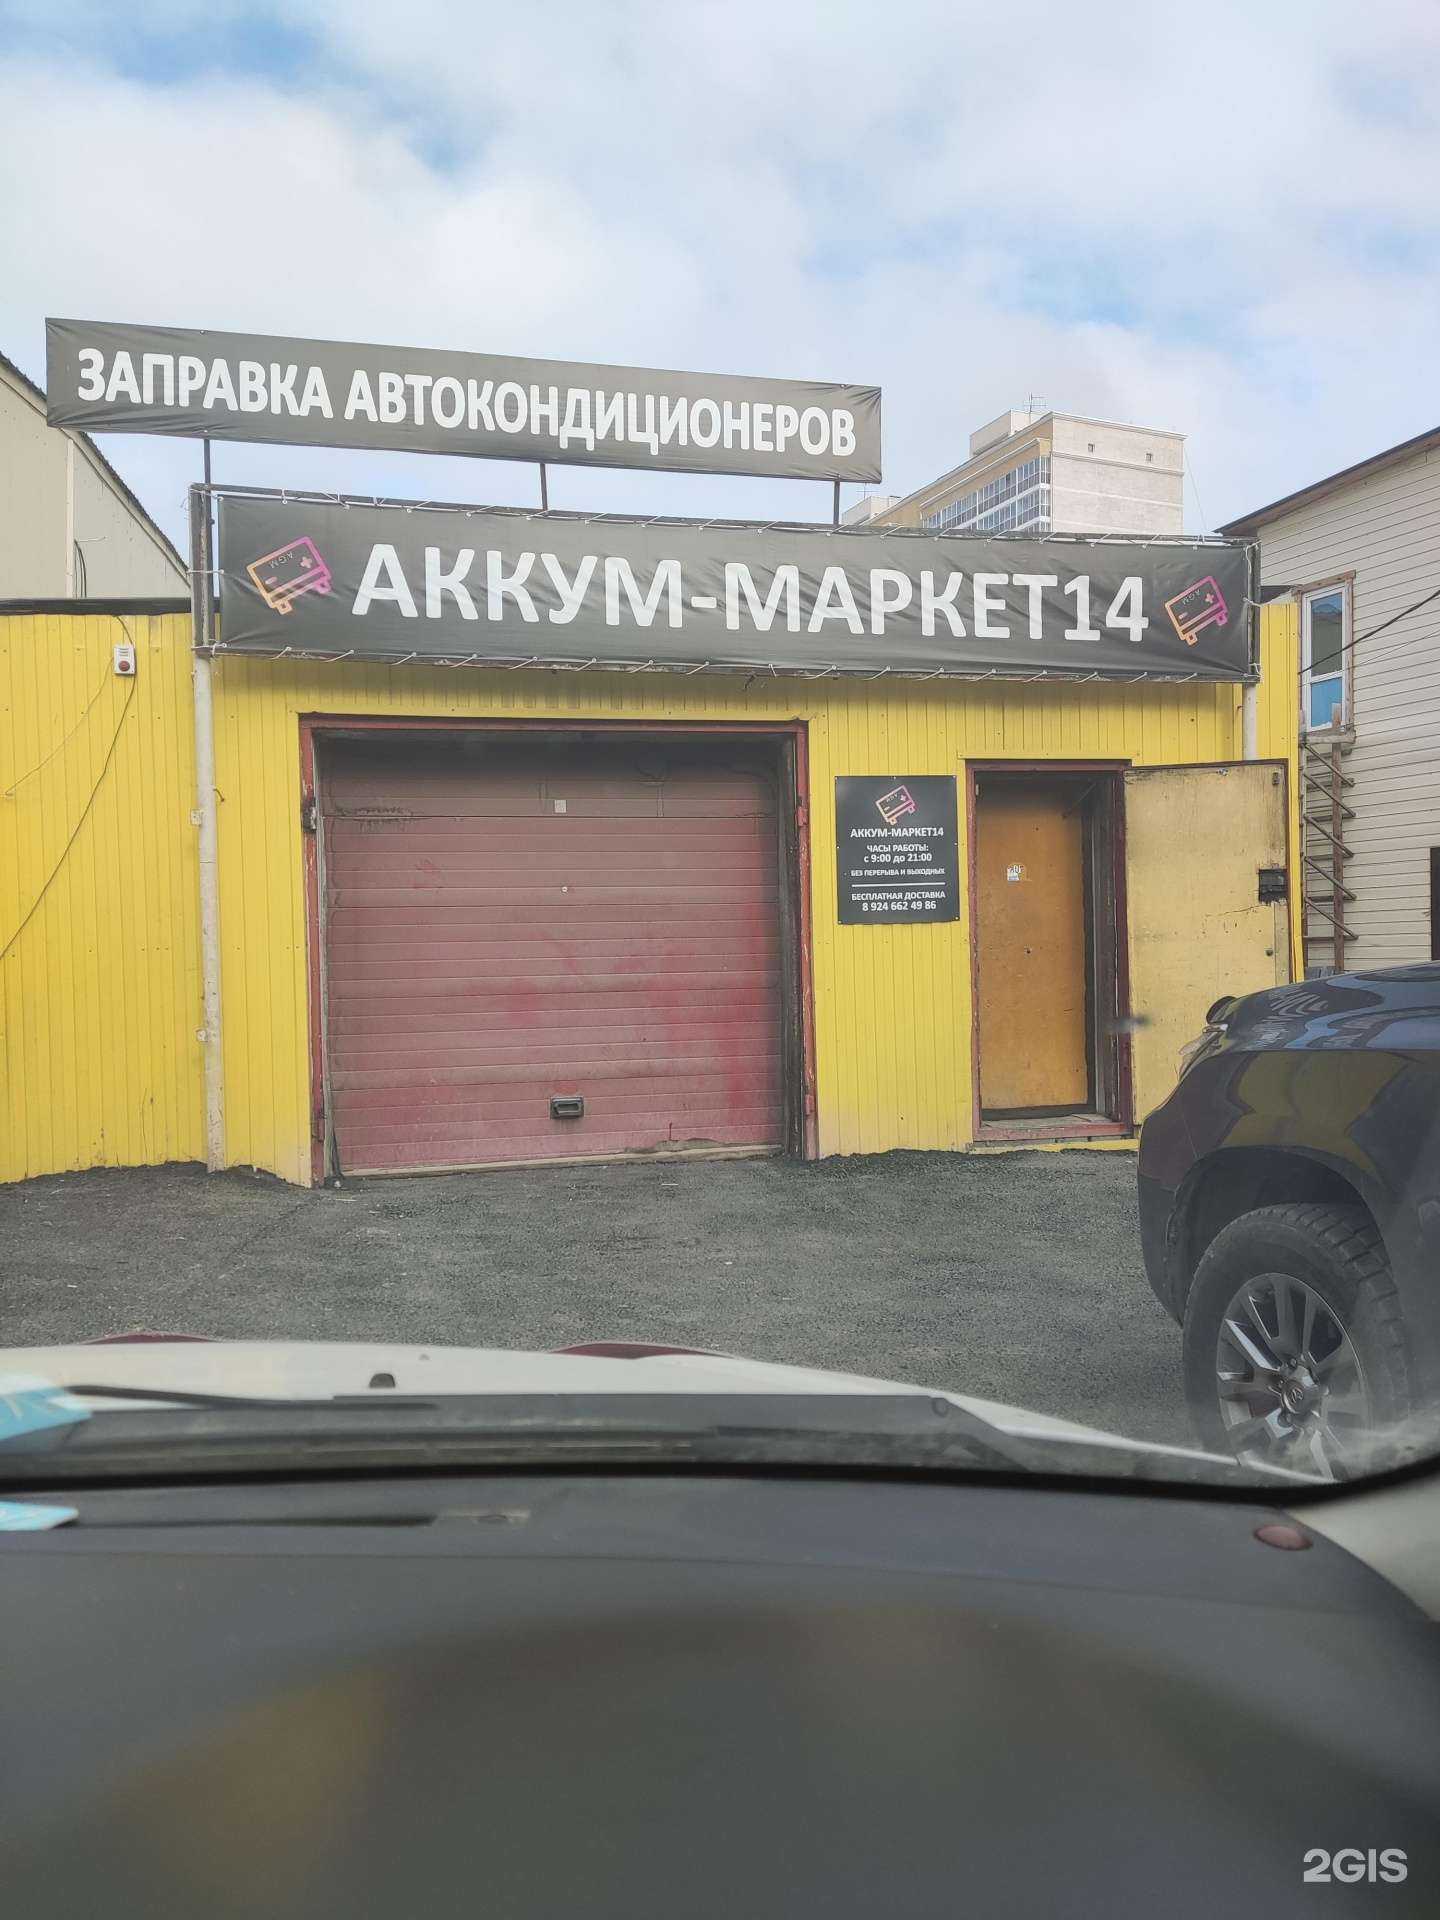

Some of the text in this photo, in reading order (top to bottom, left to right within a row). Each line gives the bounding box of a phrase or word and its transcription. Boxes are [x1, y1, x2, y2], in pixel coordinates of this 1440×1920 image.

[78, 348, 857, 456] ЗАПРАВКА АВТОКОНДИЦИОНЕРОВ
[352, 544, 1149, 642] АККУМ-МАРКЕТ14
[850, 827, 944, 838] АККУМ-МАРКЕТ14
[866, 843, 930, 853] ЧАСЫ РАБОТЫ:
[871, 854, 891, 863] 9:00
[892, 855, 906, 864] до
[907, 853, 932, 862] 21:00
[906, 868, 945, 876] ВЫХОДНЫХ
[851, 891, 946, 900] БЕСПЛАТНАЯ ДОСТАВКА
[862, 901, 937, 911] 8 924 662 49 86
